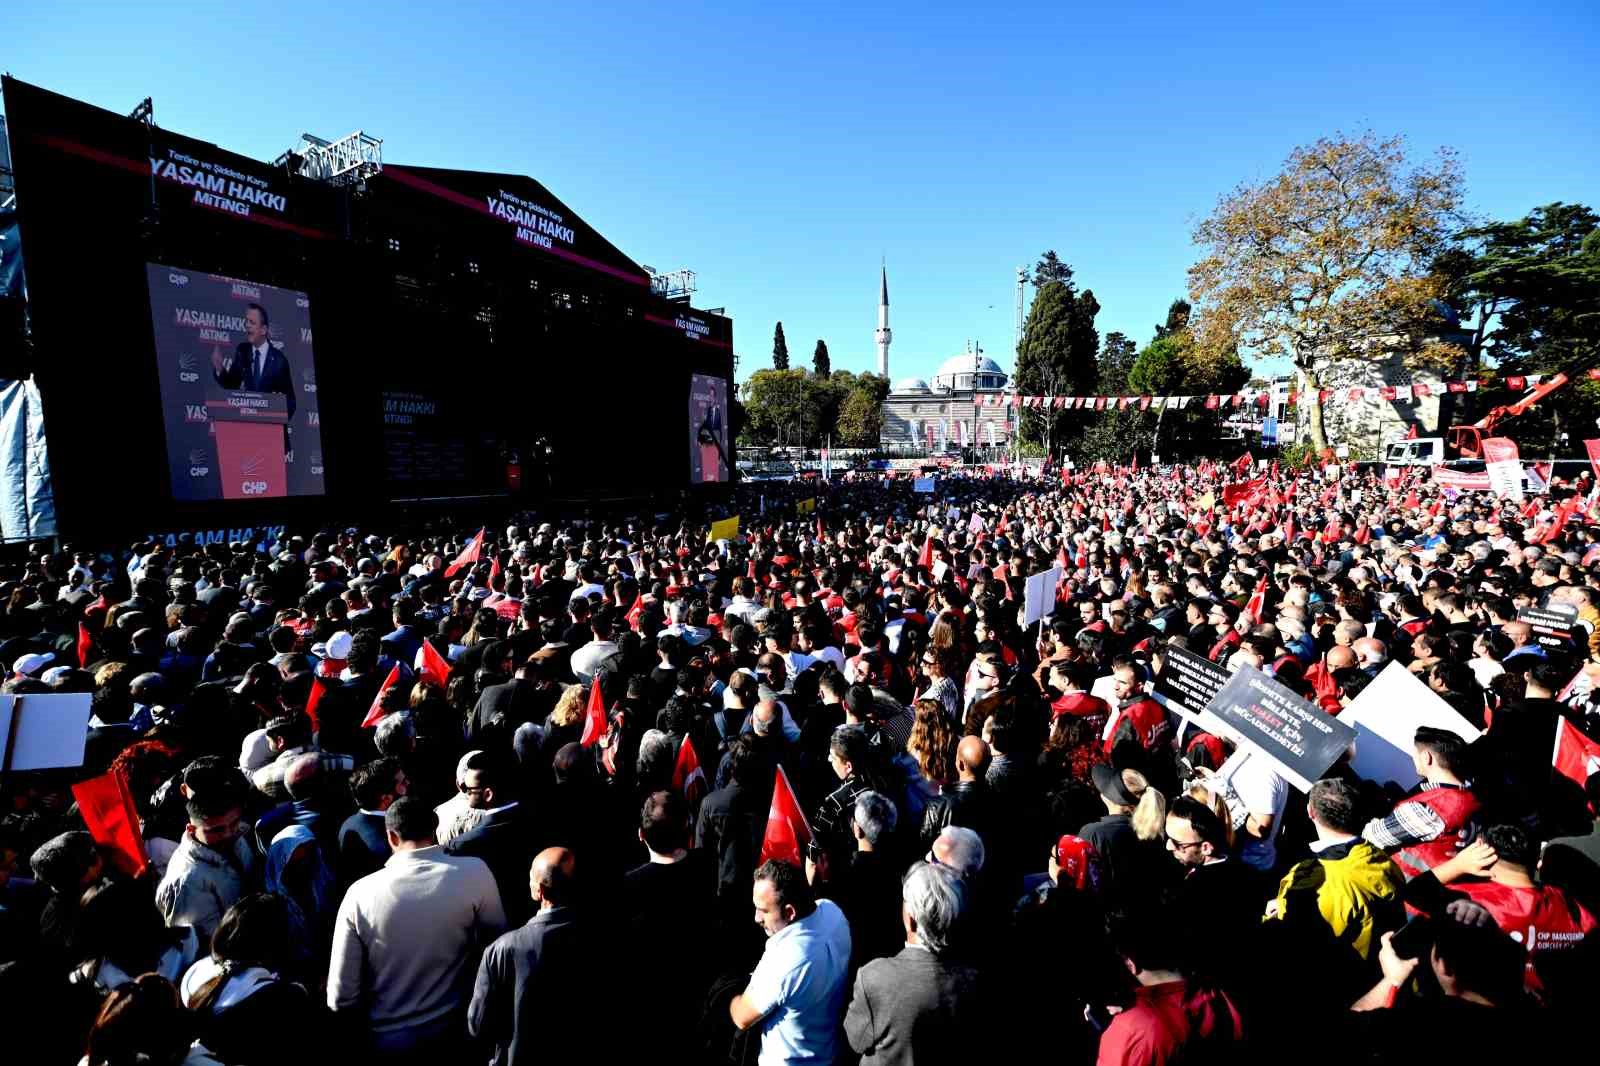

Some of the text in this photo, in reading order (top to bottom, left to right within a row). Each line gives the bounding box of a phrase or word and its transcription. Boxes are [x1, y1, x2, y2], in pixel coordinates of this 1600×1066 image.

[200, 160, 212, 170] ve
[148, 157, 287, 212] YAŞAM HAKKI
[486, 196, 574, 244] YAŞAM HAKKI
[168, 273, 189, 285] CHP
[176, 308, 247, 331] YAŞAM HAKK
[180, 372, 199, 382] CHP
[190, 467, 209, 477] CHP
[242, 481, 267, 494] CHP
